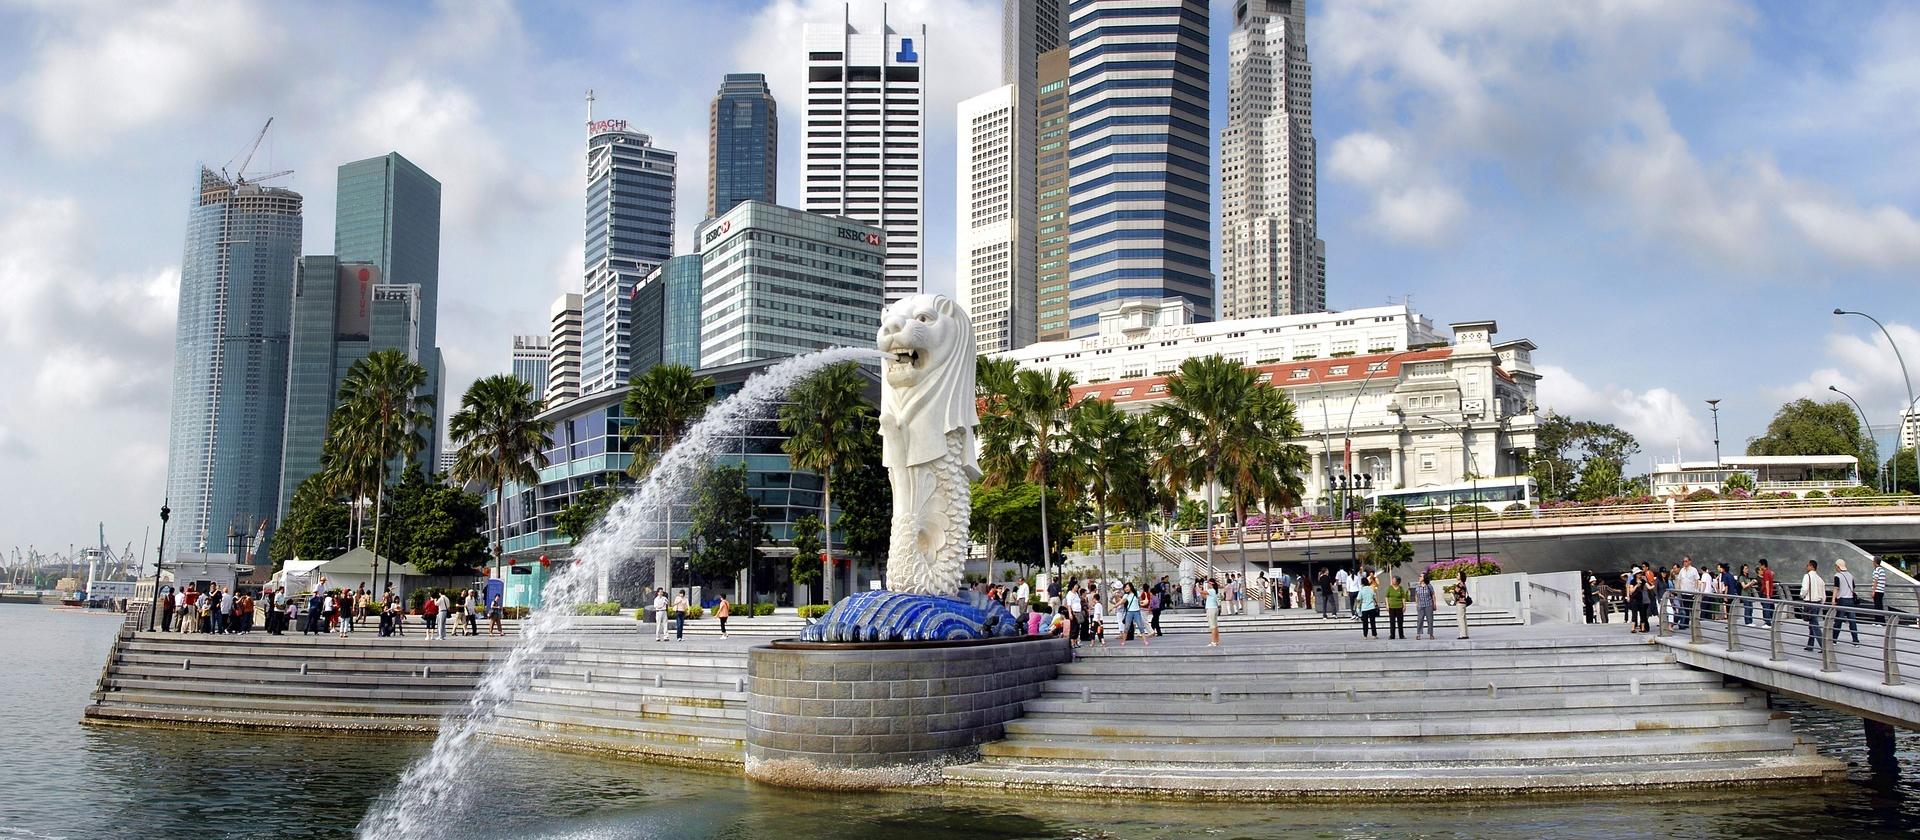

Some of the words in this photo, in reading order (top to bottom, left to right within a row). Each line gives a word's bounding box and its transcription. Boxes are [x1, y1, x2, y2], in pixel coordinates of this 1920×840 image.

[706, 226, 721, 244] HSBC
[837, 227, 865, 242] HSBC
[1080, 339, 1098, 350] THE
[1102, 331, 1159, 347] FULLERTON
[1163, 327, 1196, 338] HOTEL
